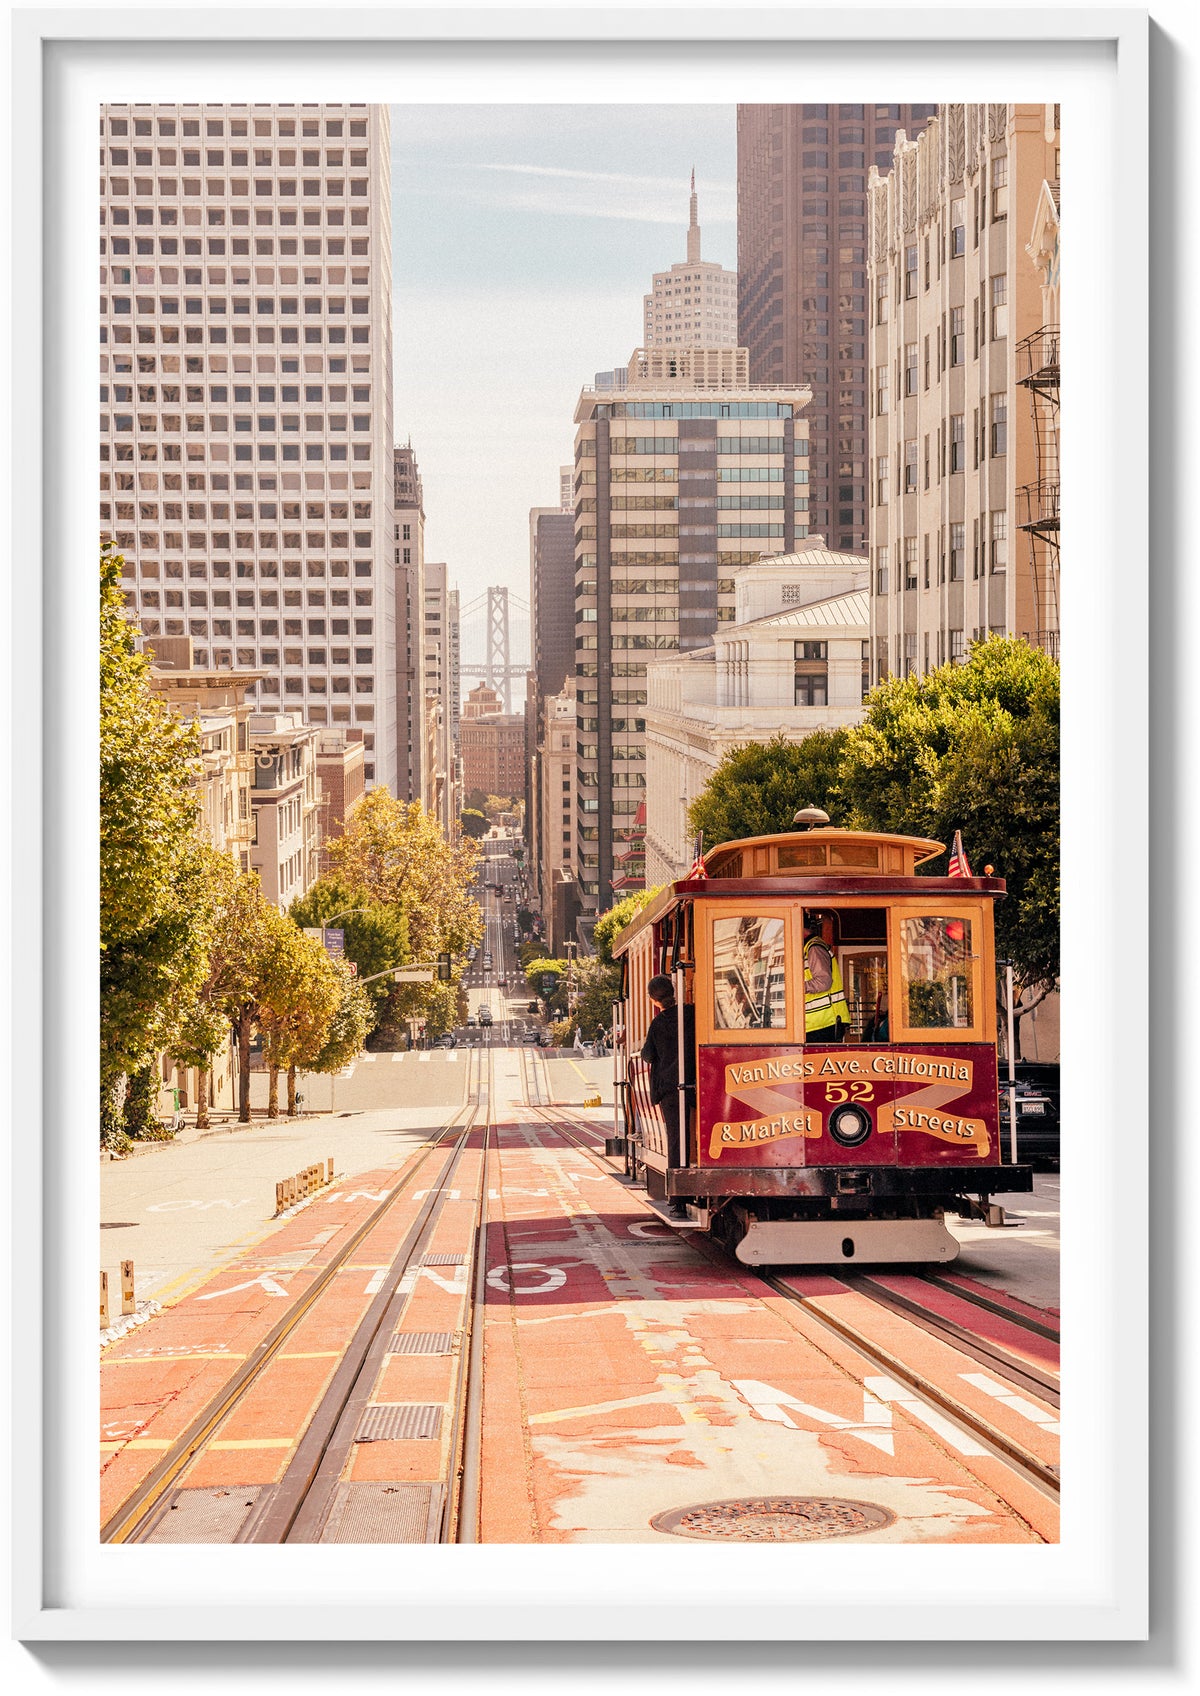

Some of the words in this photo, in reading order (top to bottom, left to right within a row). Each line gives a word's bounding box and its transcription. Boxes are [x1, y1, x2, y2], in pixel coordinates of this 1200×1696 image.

[728, 1066, 765, 1085] Van
[767, 1061, 815, 1081] Ness
[871, 1057, 970, 1081] California
[824, 1081, 875, 1103] 52
[720, 1125, 737, 1142] &
[739, 1114, 813, 1143] Market
[893, 1108, 976, 1138] Streets
